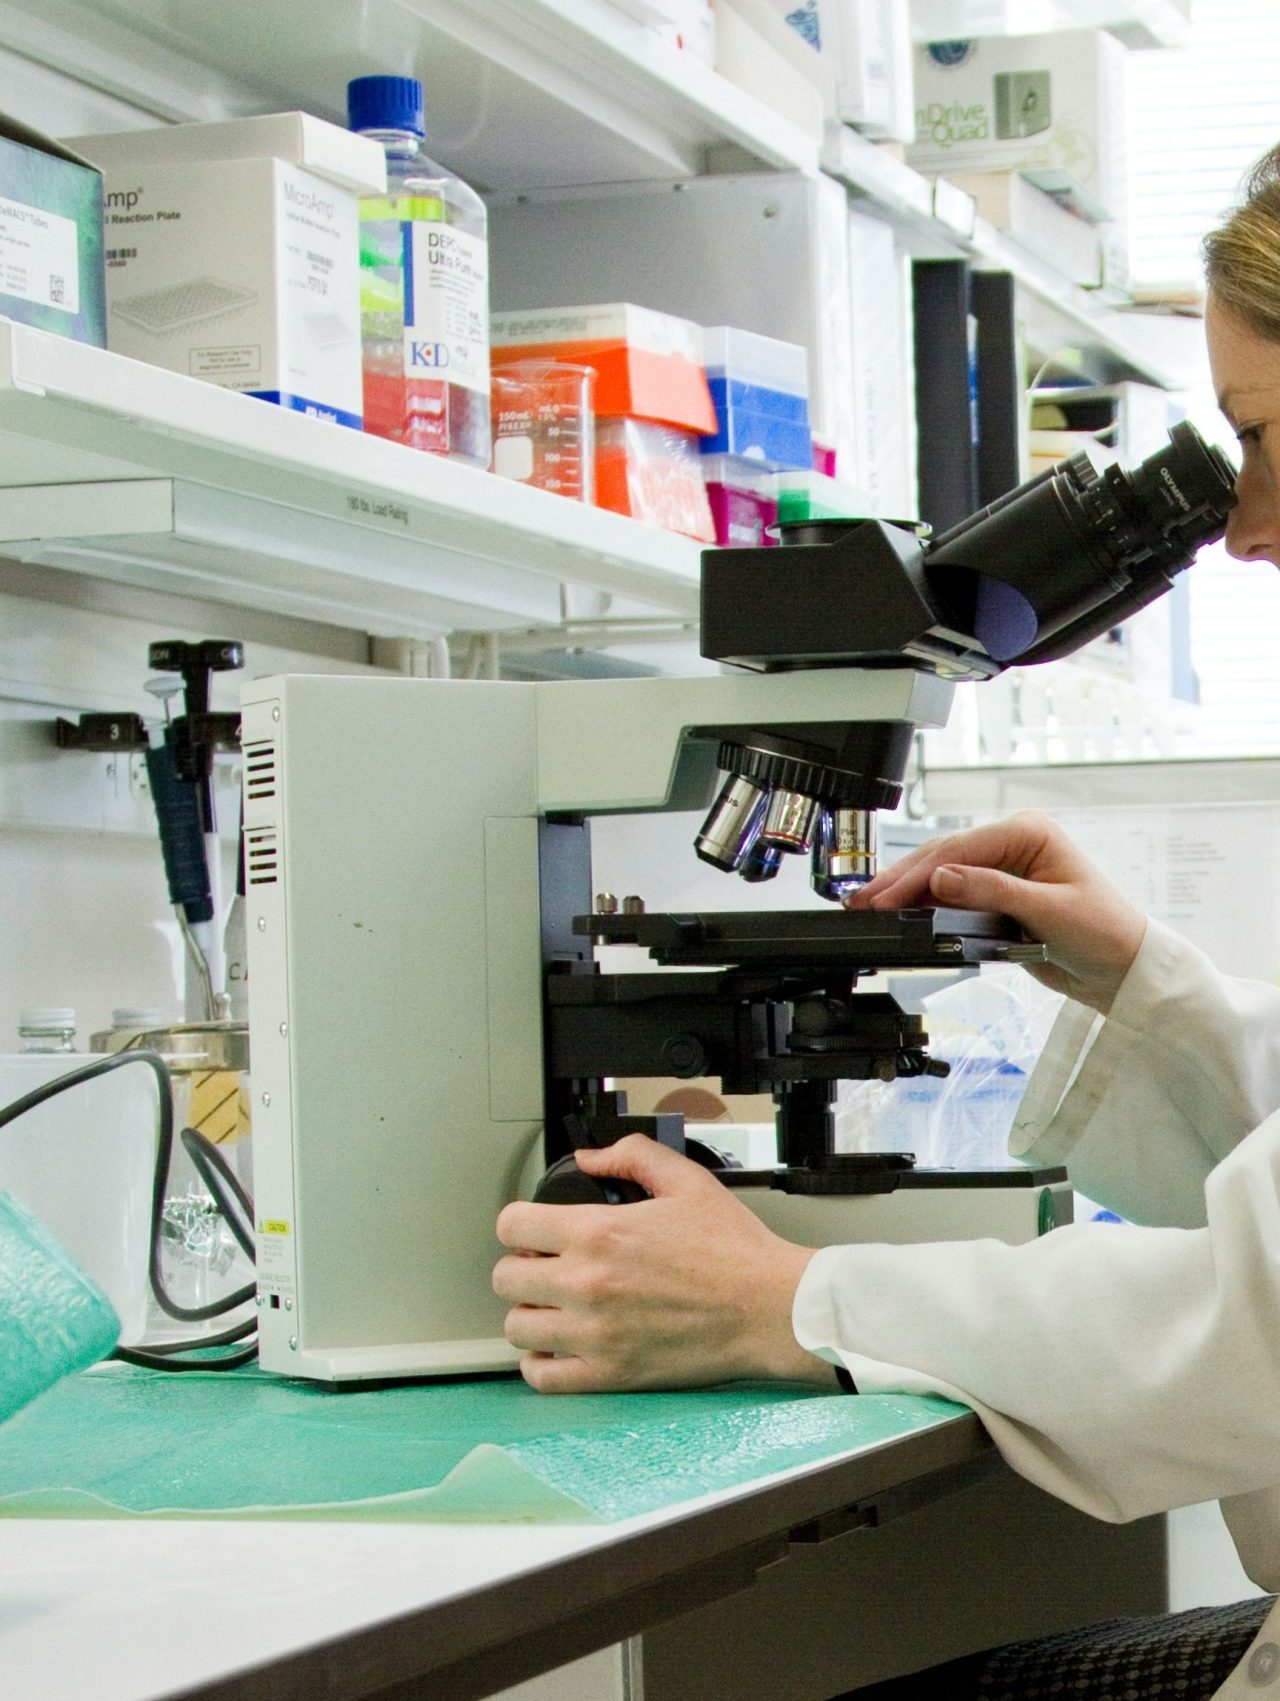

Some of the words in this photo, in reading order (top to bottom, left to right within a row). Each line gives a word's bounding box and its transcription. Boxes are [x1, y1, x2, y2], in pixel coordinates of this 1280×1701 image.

[931, 122, 988, 147] Quad
[112, 214, 154, 224] Reaction
[156, 211, 181, 221] Plate
[547, 426, 560, 436] 50
[544, 453, 561, 463] 100
[1160, 467, 1191, 512] OLYMPUS
[110, 724, 119, 740] 3
